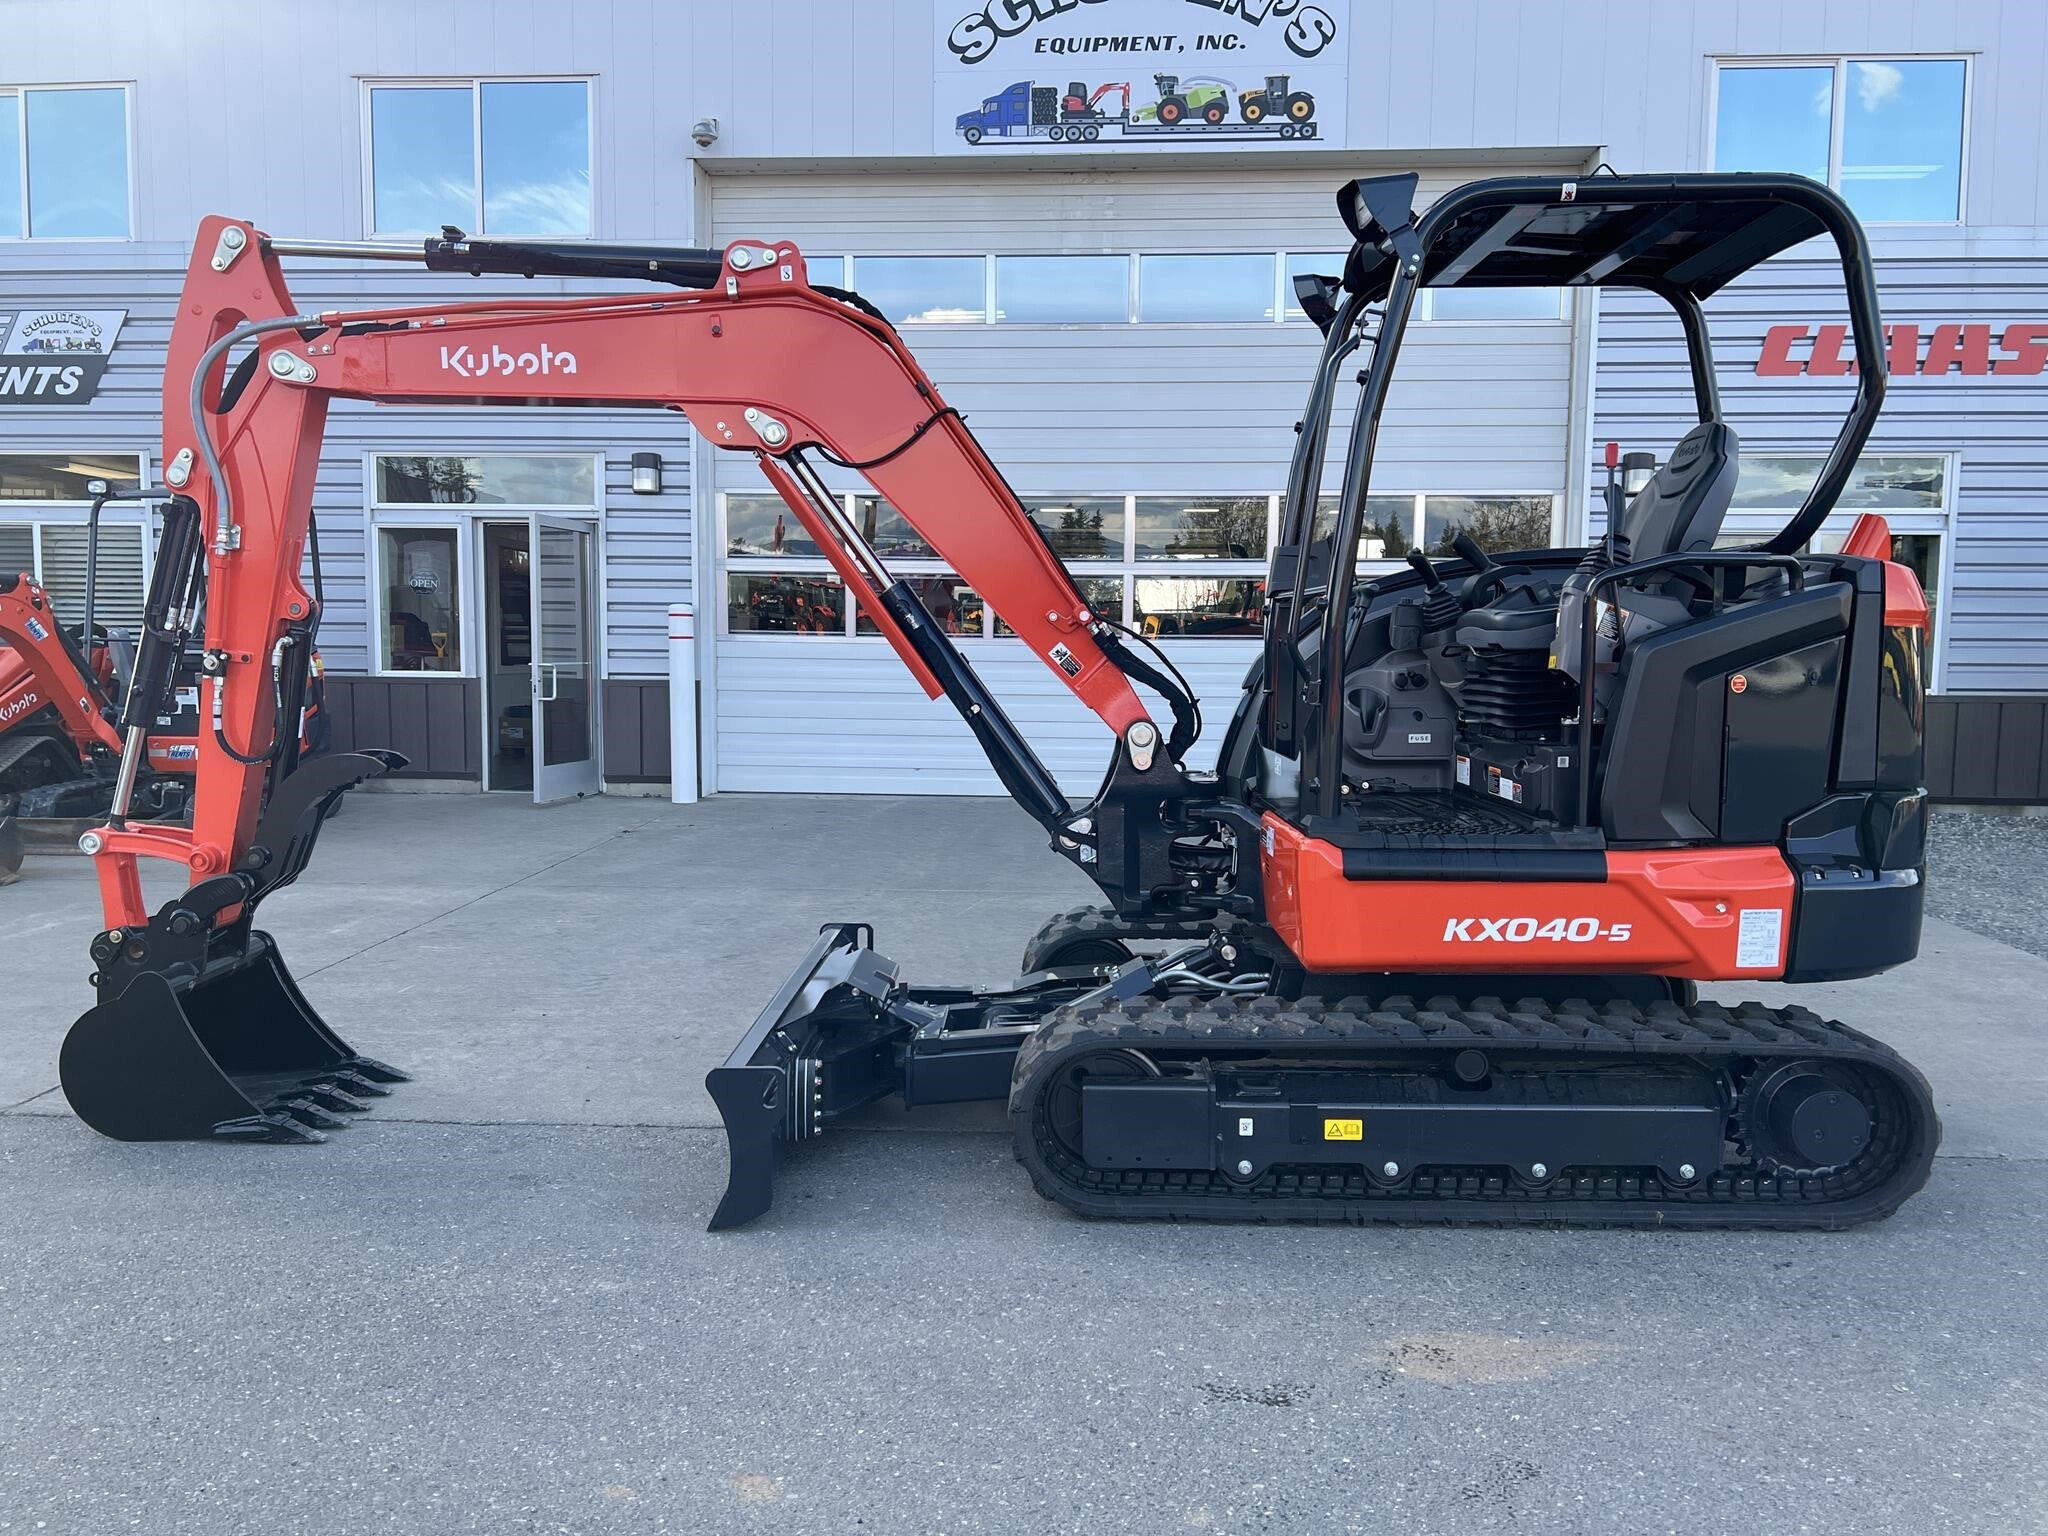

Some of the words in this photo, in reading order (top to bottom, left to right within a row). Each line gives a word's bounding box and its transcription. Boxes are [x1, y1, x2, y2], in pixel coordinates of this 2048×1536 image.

[1034, 35, 1185, 55] EQUIPMENT,
[1195, 33, 1247, 51] INC.
[22, 311, 102, 337] SCHOLTEN'S
[440, 343, 577, 377] Kubota
[1755, 324, 2048, 377] CLAAS
[410, 578, 438, 588] OPEN
[1442, 917, 1633, 942] KX040-5
